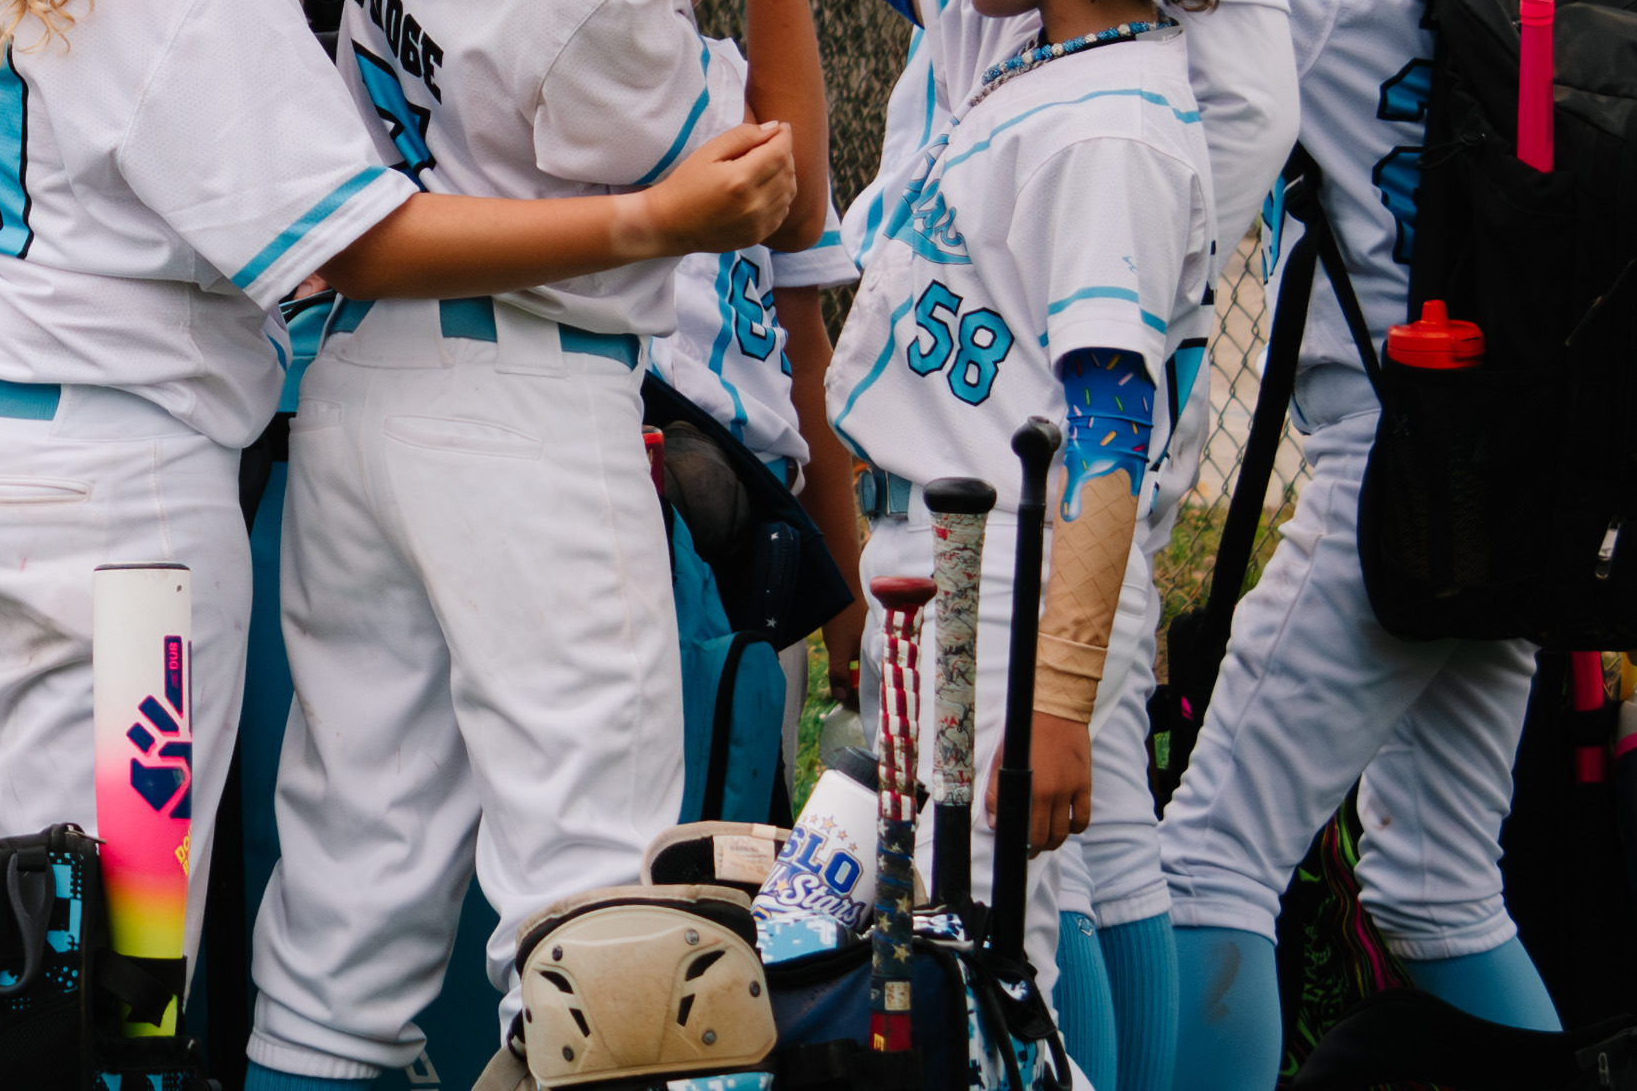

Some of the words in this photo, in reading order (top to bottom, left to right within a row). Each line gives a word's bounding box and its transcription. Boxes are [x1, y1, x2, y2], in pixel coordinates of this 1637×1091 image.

[907, 279, 1015, 406] 58
[777, 823, 863, 897] SLO
[777, 872, 866, 927] Stars
